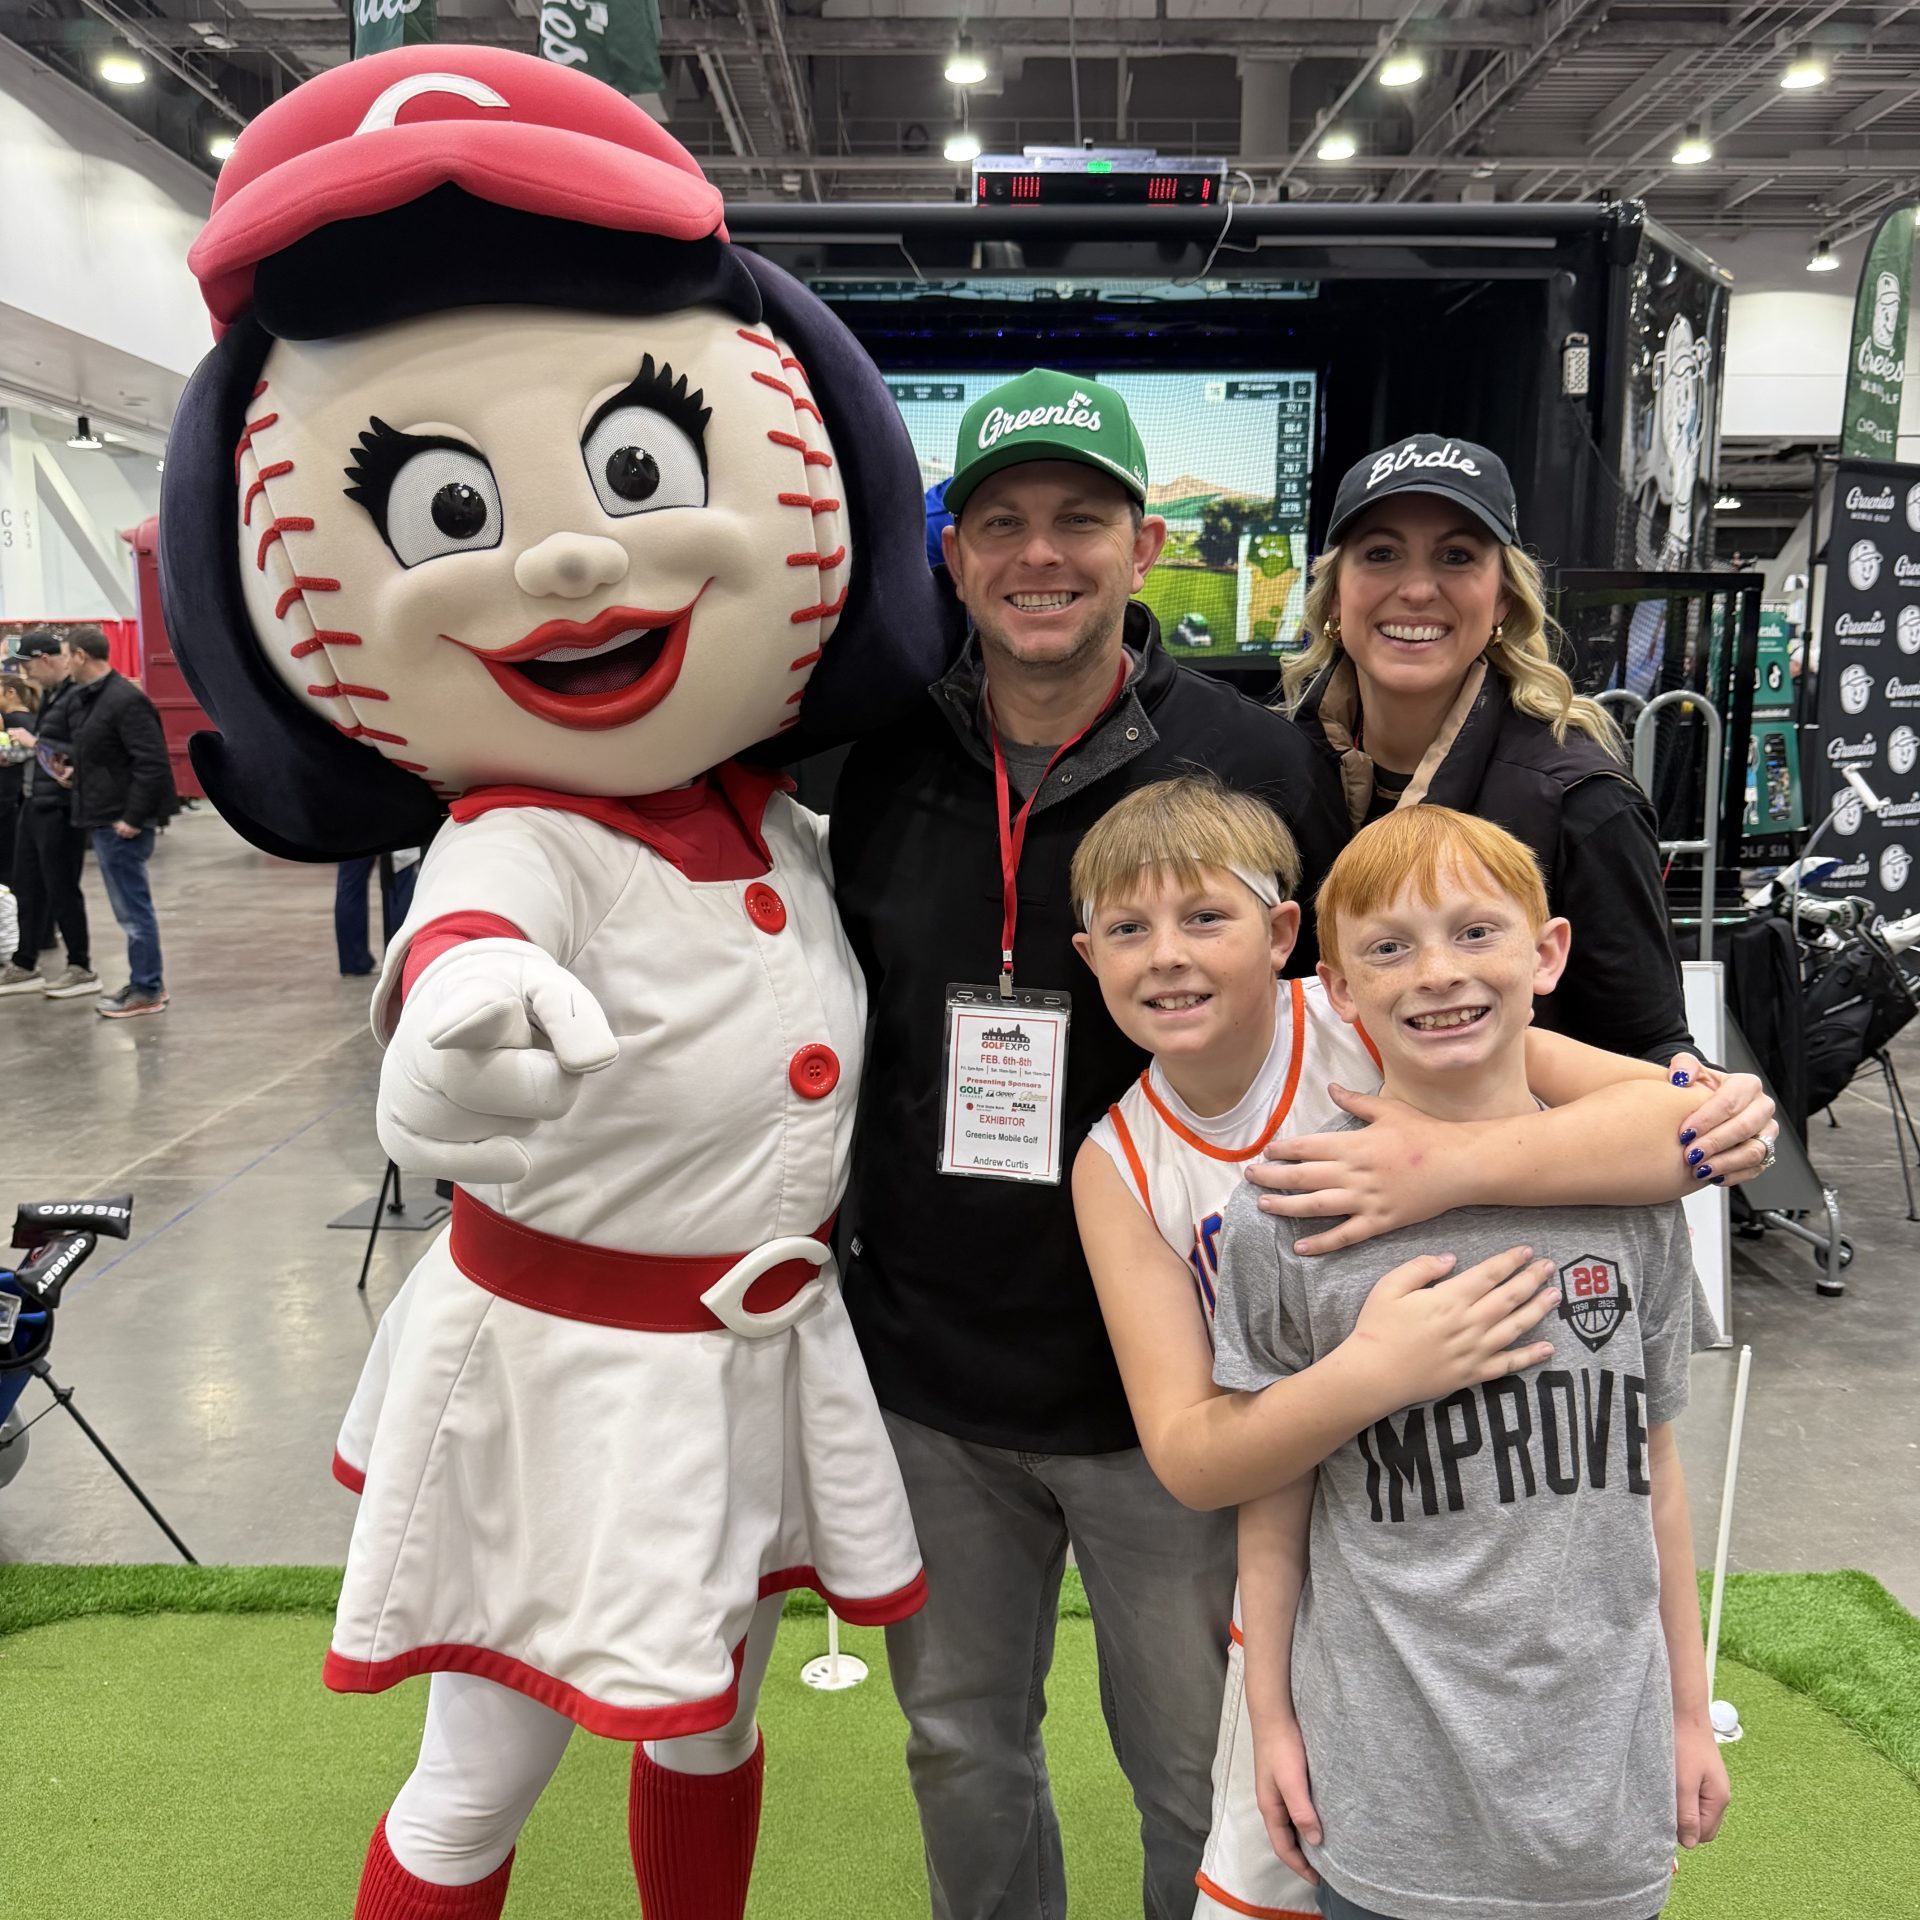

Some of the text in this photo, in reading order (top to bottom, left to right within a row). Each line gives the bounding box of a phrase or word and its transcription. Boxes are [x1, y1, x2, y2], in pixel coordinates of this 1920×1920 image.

[978, 390, 1102, 450] Greenies
[1366, 443, 1481, 490] Birdie
[980, 1054, 1033, 1067] FEB. 6th-8th
[966, 1076, 1042, 1089] Presenting Sponsors
[959, 1085, 984, 1095] GOLF
[979, 1114, 1025, 1127] EXHIBITOR
[965, 1130, 1038, 1144] Greenies Mobile Golf
[973, 1156, 1029, 1169] Andrew Curtis
[38, 1204, 131, 1219] ODYSSEY
[36, 1237, 87, 1295] ODYSSEY
[1572, 1265, 1610, 1297] 28
[1357, 1367, 1652, 1523] IMPROVE
